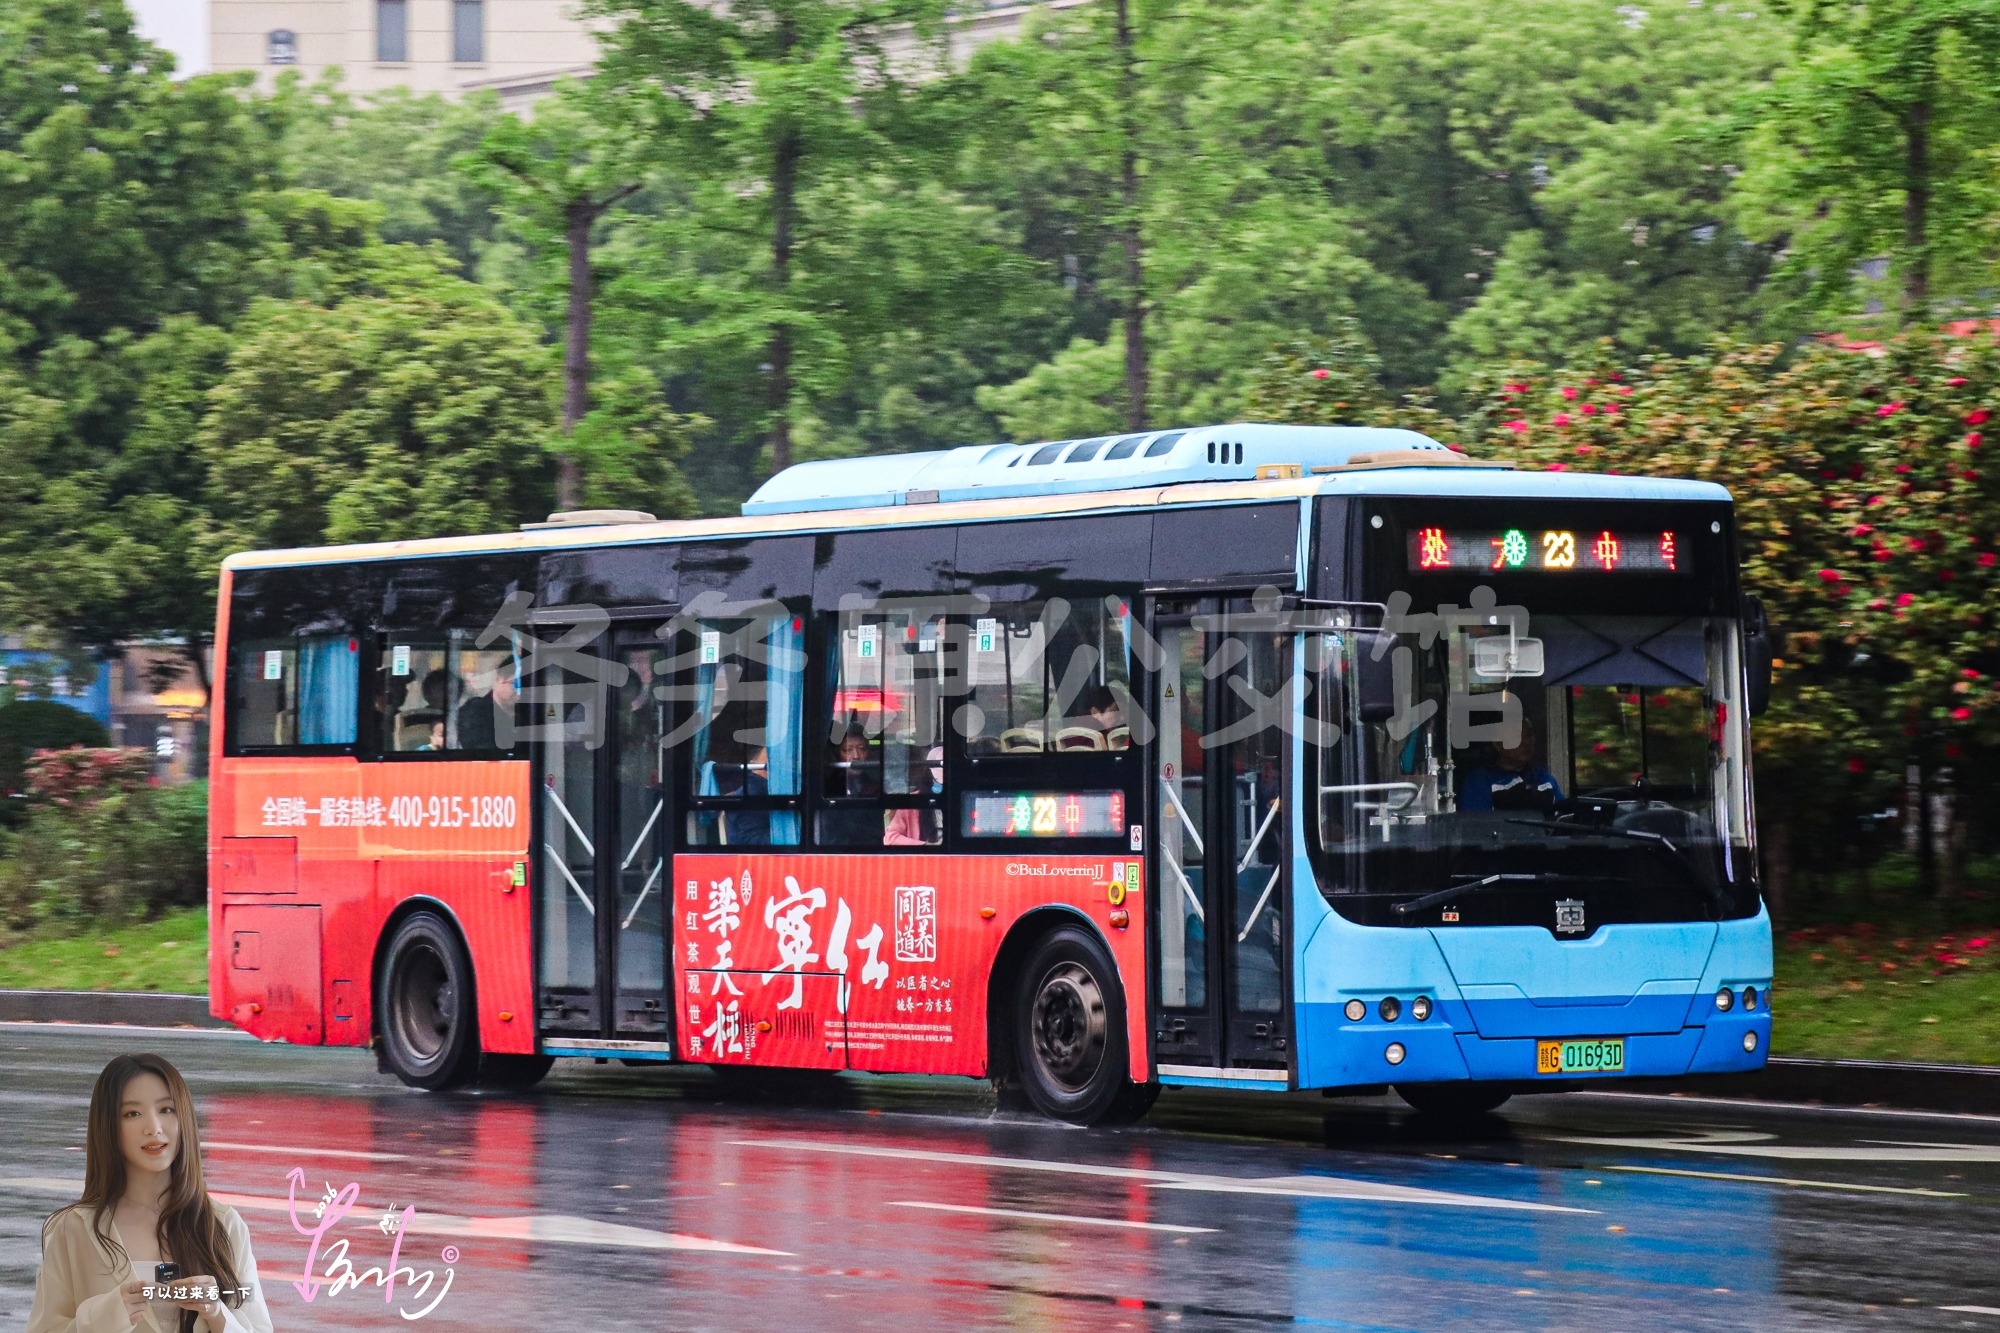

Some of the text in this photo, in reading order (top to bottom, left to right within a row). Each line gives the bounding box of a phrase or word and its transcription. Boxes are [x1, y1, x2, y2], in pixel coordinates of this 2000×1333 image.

[1544, 531, 1575, 566] 23
[1033, 797, 1057, 832] 23
[686, 880, 701, 1057] 用红茶观世界
[896, 975, 951, 990] 以医者之心
